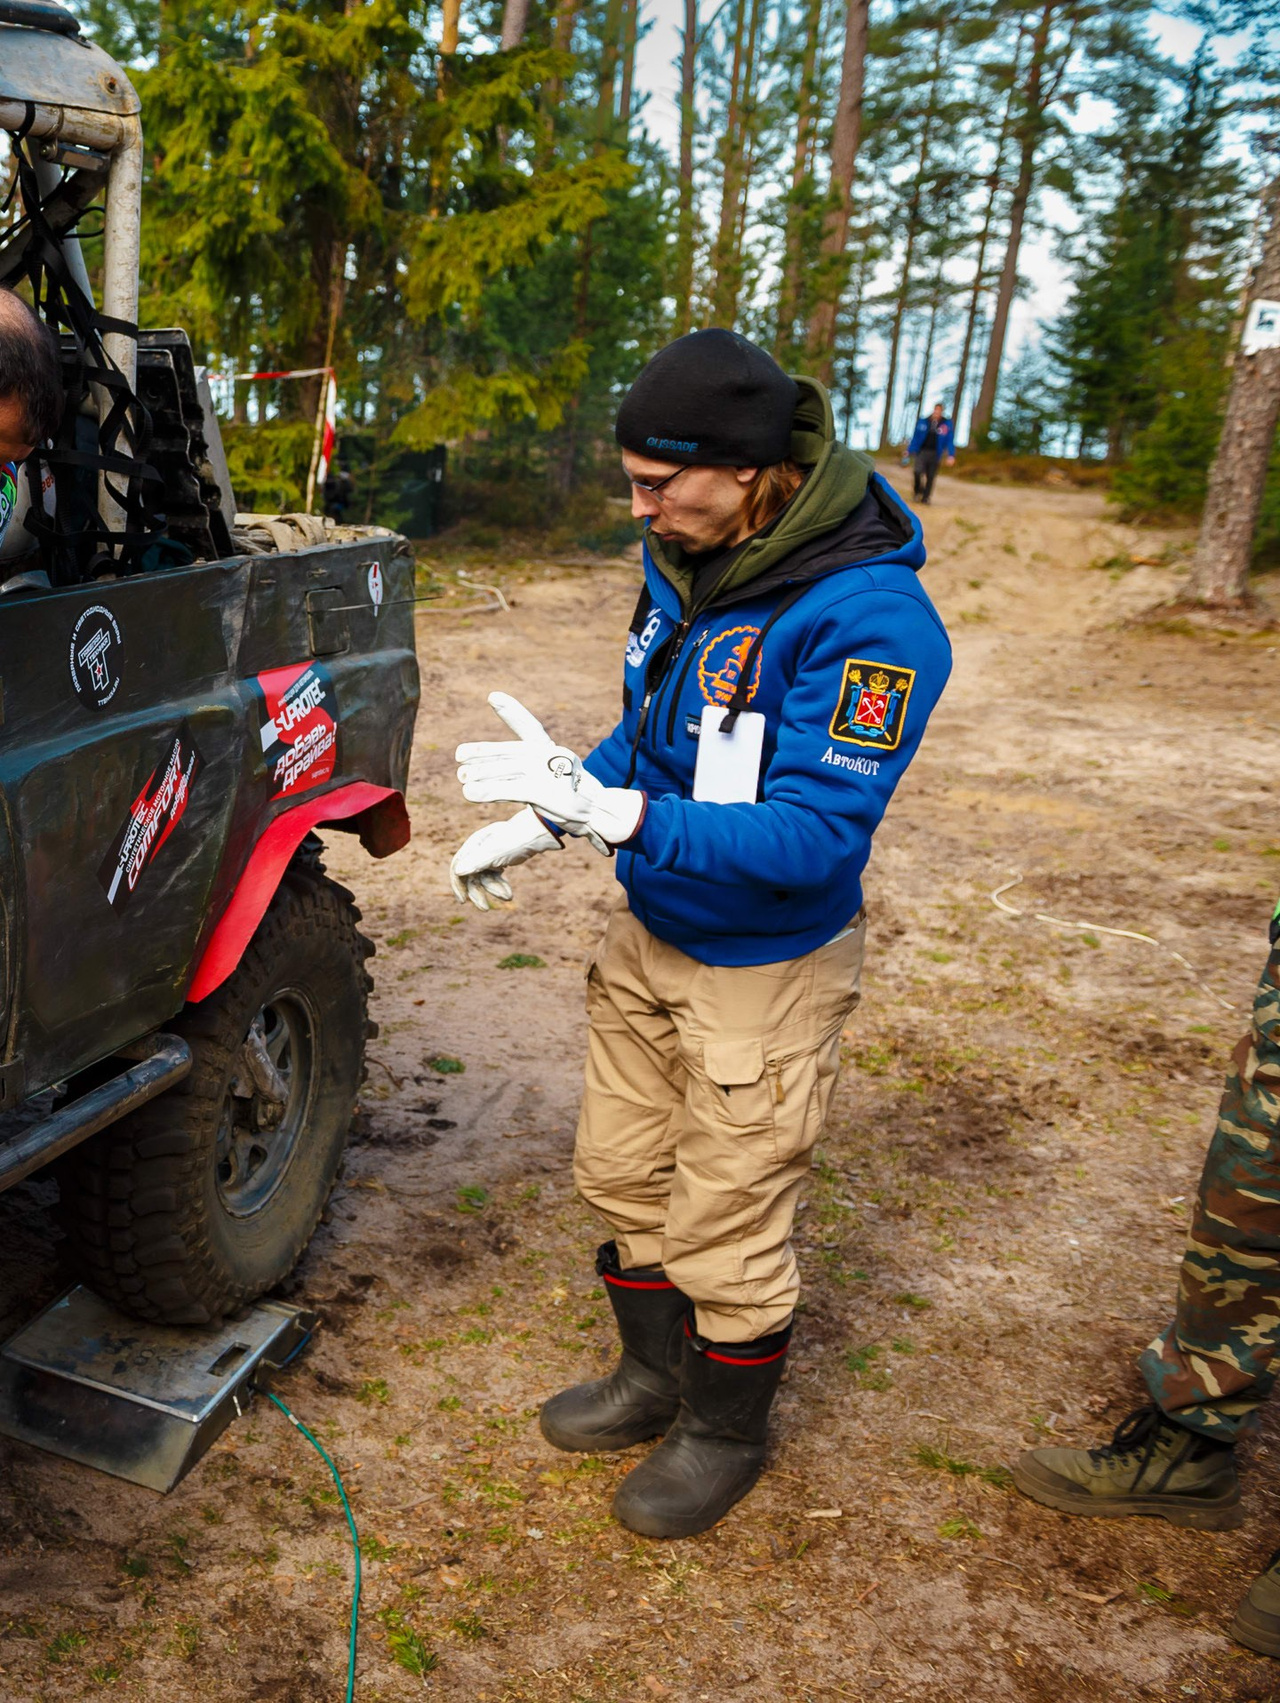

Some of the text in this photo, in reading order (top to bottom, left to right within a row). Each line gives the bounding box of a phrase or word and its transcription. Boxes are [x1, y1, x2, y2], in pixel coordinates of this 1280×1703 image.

[274, 677, 326, 733] SUPROTEC
[153, 765, 171, 807] МОТОРНОЕ
[119, 803, 149, 867] SUPROTEC
[128, 744, 181, 892] COMFORT
